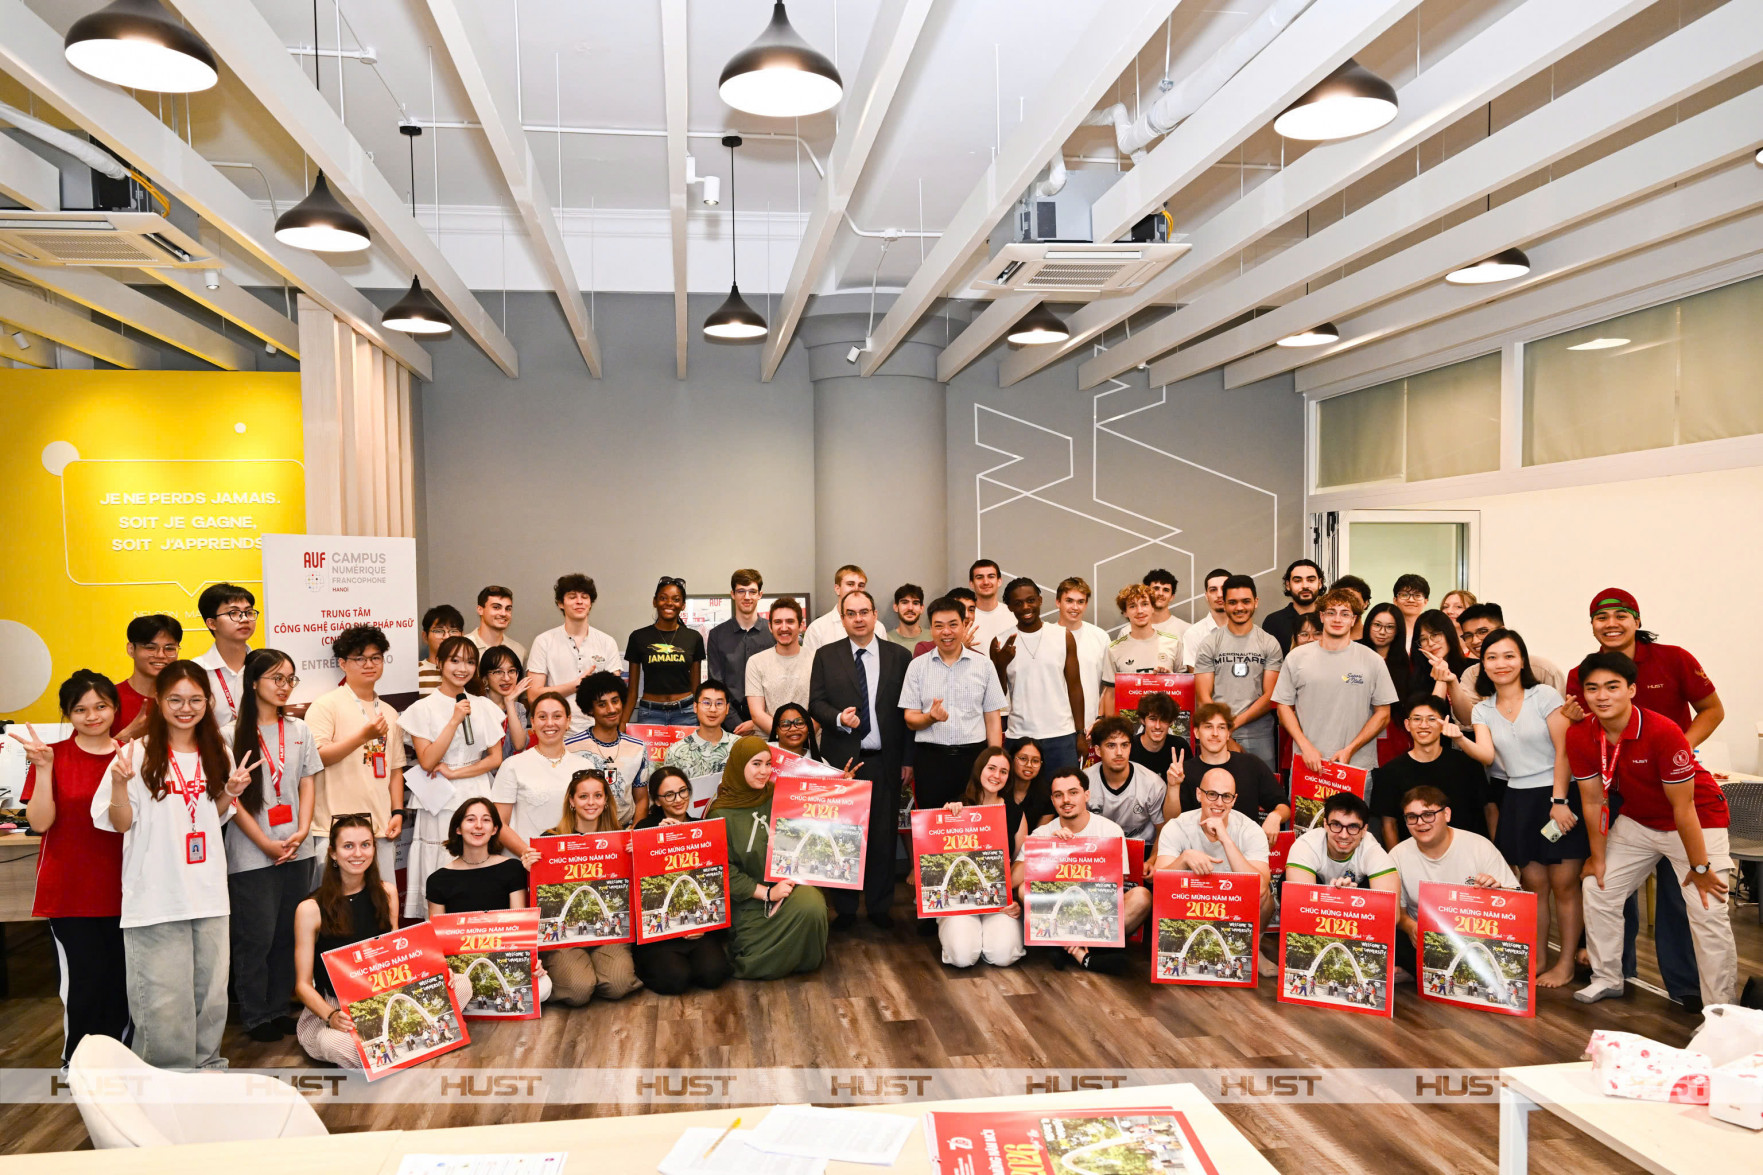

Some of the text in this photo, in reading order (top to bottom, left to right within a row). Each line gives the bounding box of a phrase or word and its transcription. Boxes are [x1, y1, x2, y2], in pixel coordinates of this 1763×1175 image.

[100, 492, 280, 505] JE NE PERDS JAMAIS.
[119, 516, 257, 529] SOIT JE GAGNE,
[112, 537, 262, 551] SOIT J'APPRENDS
[304, 552, 325, 568] AUF
[332, 552, 386, 563] CAMPUS
[332, 564, 386, 576] NUMÉRIQUE
[321, 607, 371, 618] TRUNG TÂM
[274, 623, 301, 633] CÔNG
[303, 621, 328, 634] NGHỆ
[330, 621, 351, 631] GIÁO
[373, 619, 394, 629] PHÁP
[396, 618, 414, 628] NGỮ
[648, 654, 685, 663] JAMAICA
[802, 803, 839, 819] 2026
[943, 834, 978, 850] 2026
[665, 851, 699, 870] 2026
[564, 862, 603, 879] 2026
[1056, 864, 1092, 879] 2026
[1186, 901, 1226, 918] 2026
[1343, 911, 1360, 919] NĂM
[1361, 912, 1375, 920] MỚI
[1483, 910, 1500, 919] NĂM
[1501, 912, 1516, 920] MỚI
[1315, 916, 1358, 936] 2026
[1454, 916, 1499, 936] 2026
[460, 934, 502, 950] 2026
[392, 954, 408, 965] NĂM
[409, 950, 423, 960] MỚI
[368, 964, 412, 992] 2026
